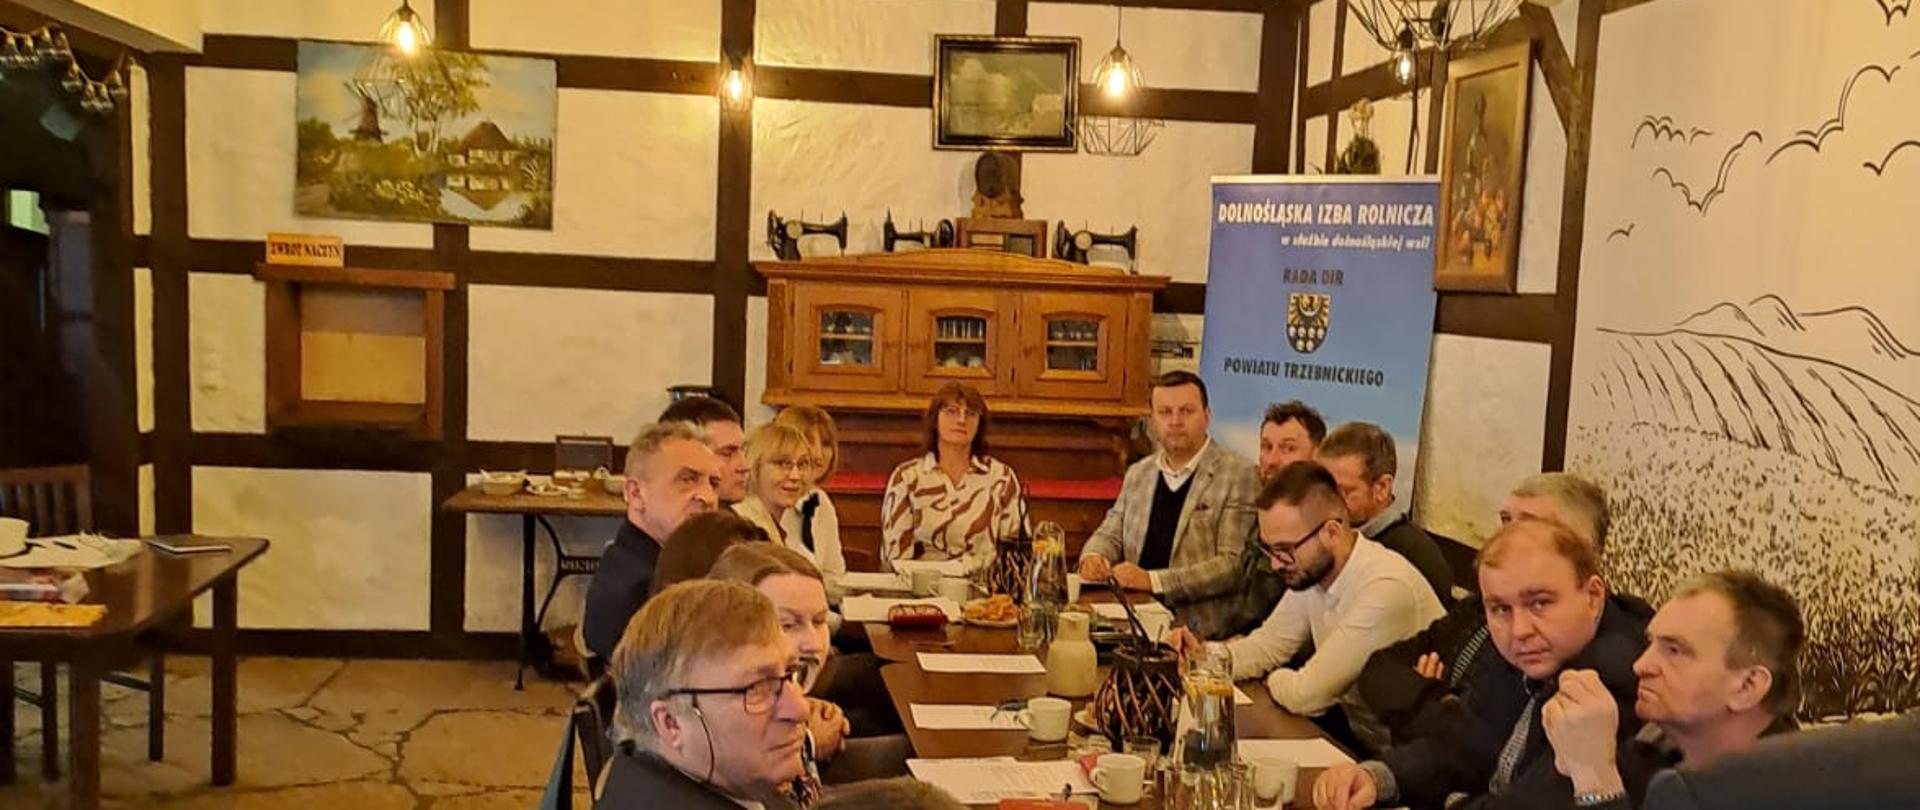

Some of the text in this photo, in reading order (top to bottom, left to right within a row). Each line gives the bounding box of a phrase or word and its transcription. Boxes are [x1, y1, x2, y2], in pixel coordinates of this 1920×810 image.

[1218, 198, 1433, 228] DOLNOŚLĄSKA IZBA ROLNICZA
[1281, 236, 1290, 246] w
[1283, 267, 1344, 285] RADA DIR
[1224, 357, 1384, 387] POWIATU TRZEBNICKIEGO
